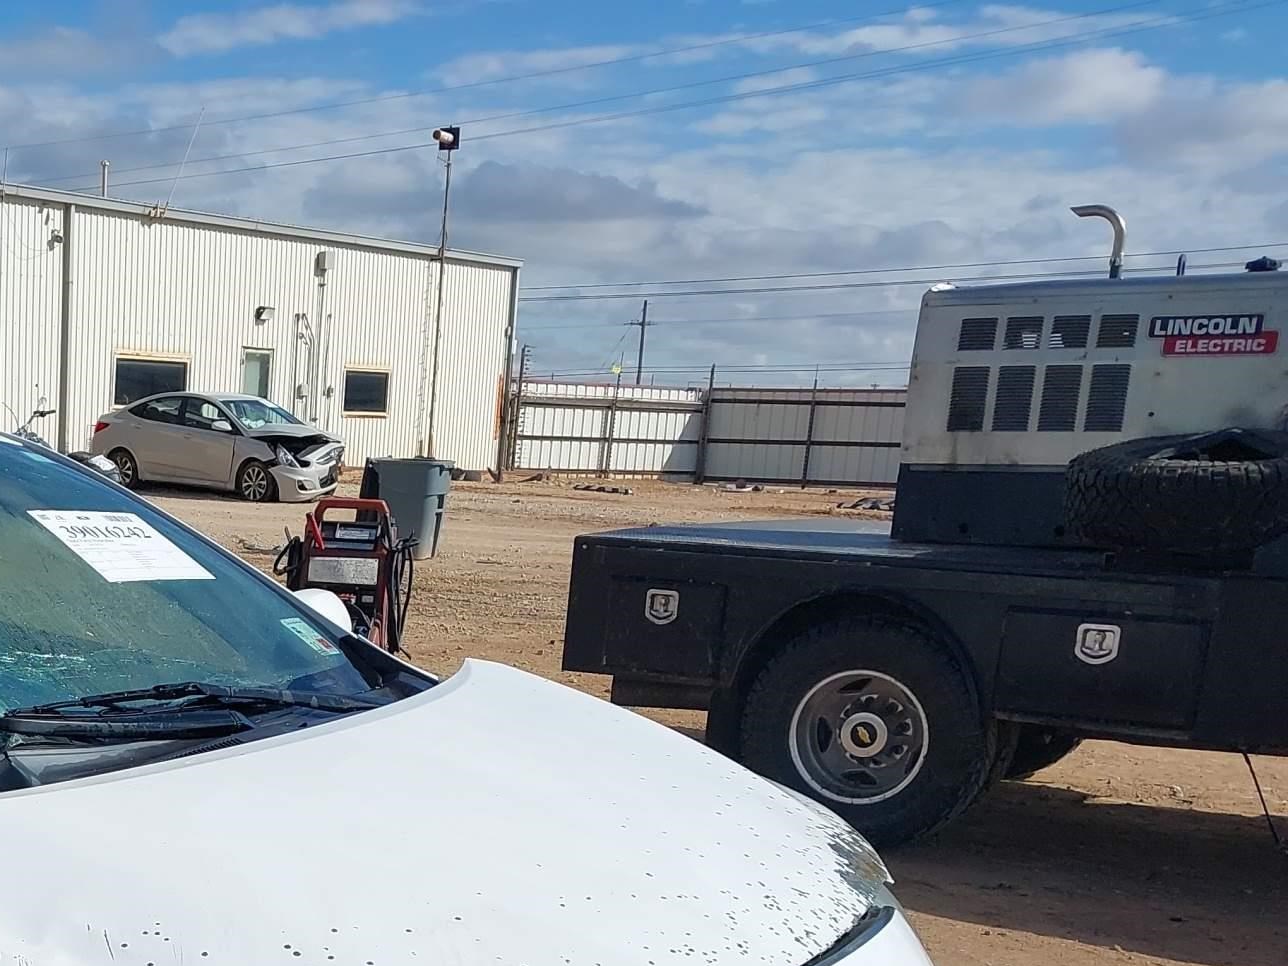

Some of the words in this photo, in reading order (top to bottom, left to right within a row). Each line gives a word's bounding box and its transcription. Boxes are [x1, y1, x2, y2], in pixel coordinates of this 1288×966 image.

[1153, 317, 1258, 336] LINCOLN
[1174, 338, 1267, 353] ELECTRIC
[59, 525, 152, 540] 39016242
